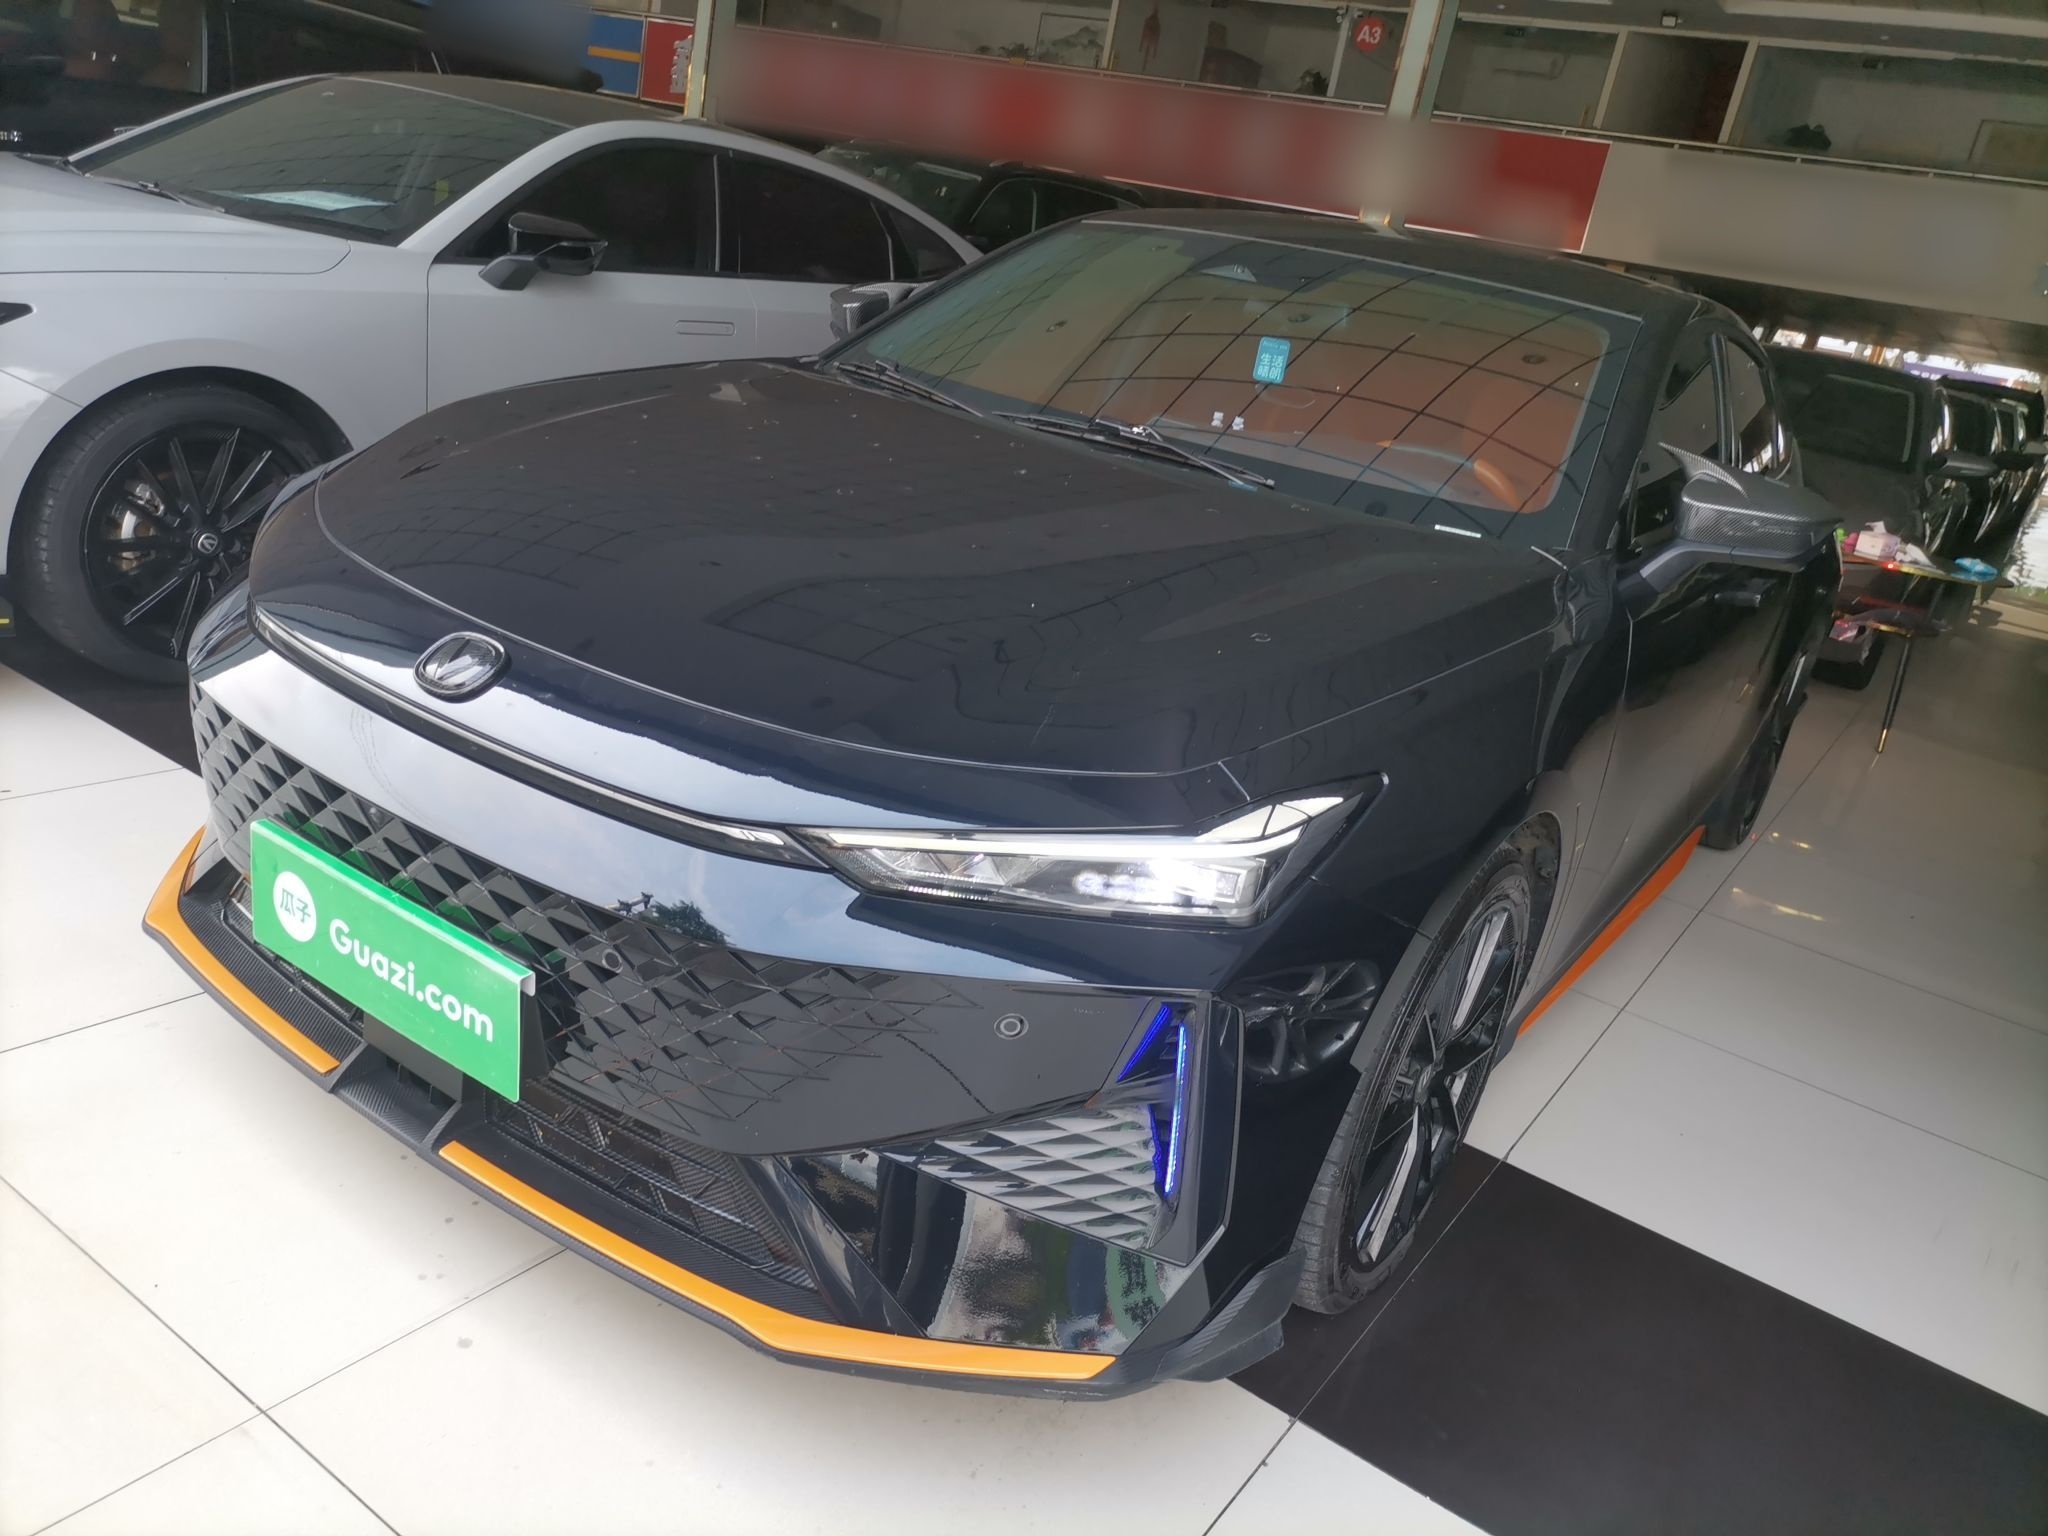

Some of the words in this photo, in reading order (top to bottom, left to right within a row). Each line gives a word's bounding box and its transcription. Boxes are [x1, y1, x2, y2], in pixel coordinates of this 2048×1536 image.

[1356, 25, 1382, 44] A3
[279, 887, 312, 924] 瓜子
[329, 918, 494, 1043] Guazi.com
